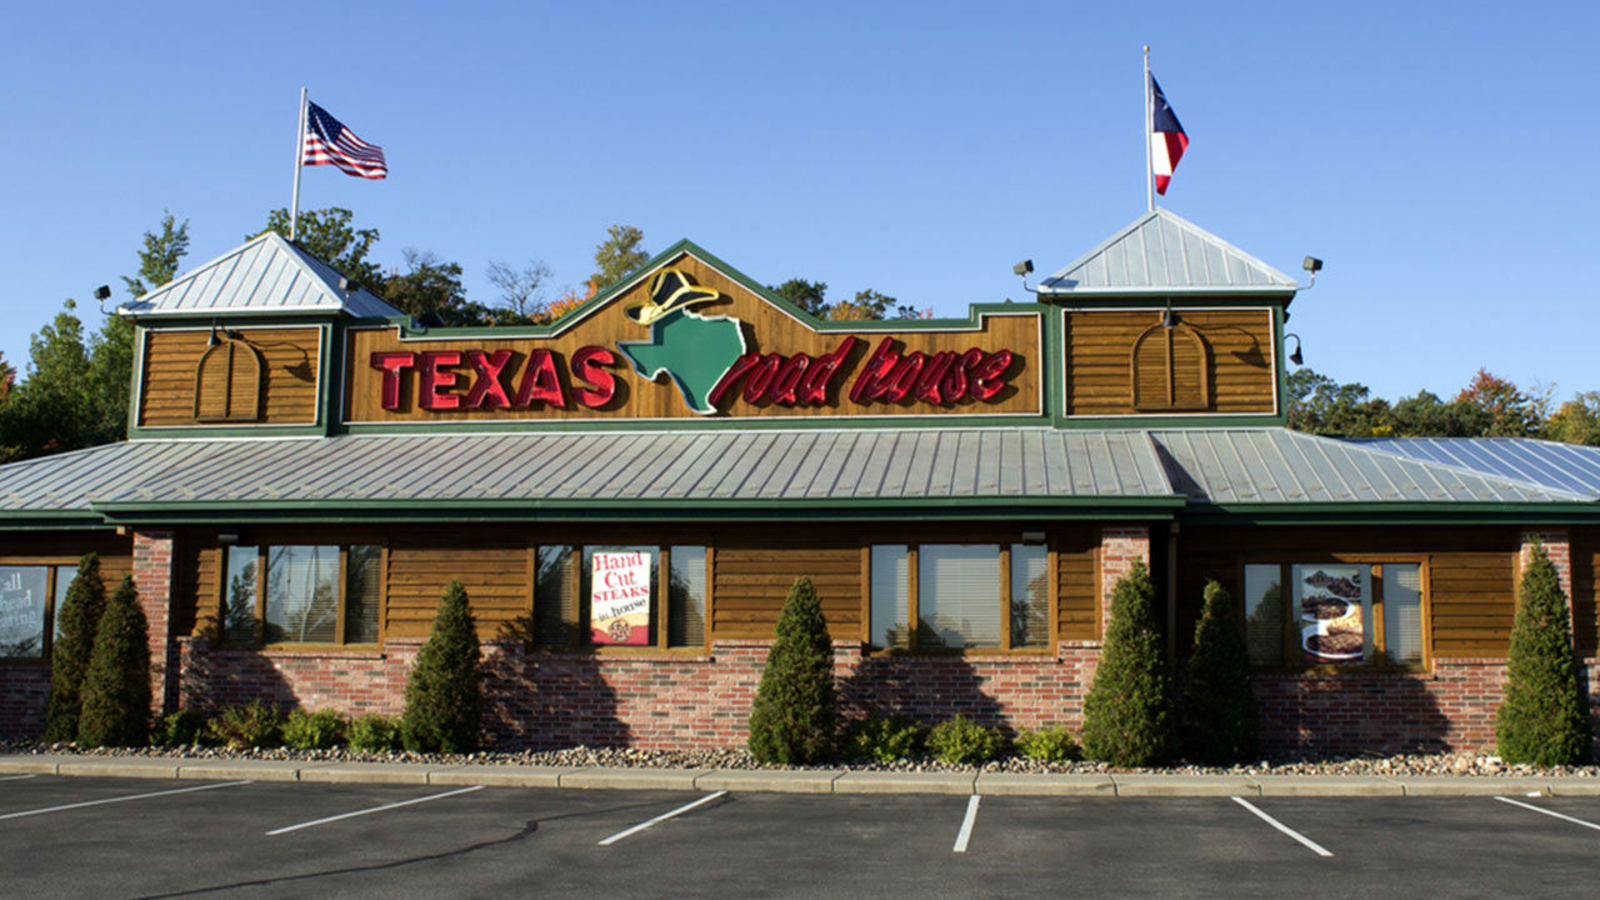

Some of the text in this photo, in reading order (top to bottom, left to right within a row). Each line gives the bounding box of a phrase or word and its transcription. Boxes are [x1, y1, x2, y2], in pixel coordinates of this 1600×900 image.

[370, 335, 1012, 409] TEXAS road house
[594, 552, 644, 572] Hand
[0, 571, 22, 591] all
[604, 570, 637, 588] Cut
[593, 585, 649, 603] STEAKS
[611, 599, 647, 618] house
